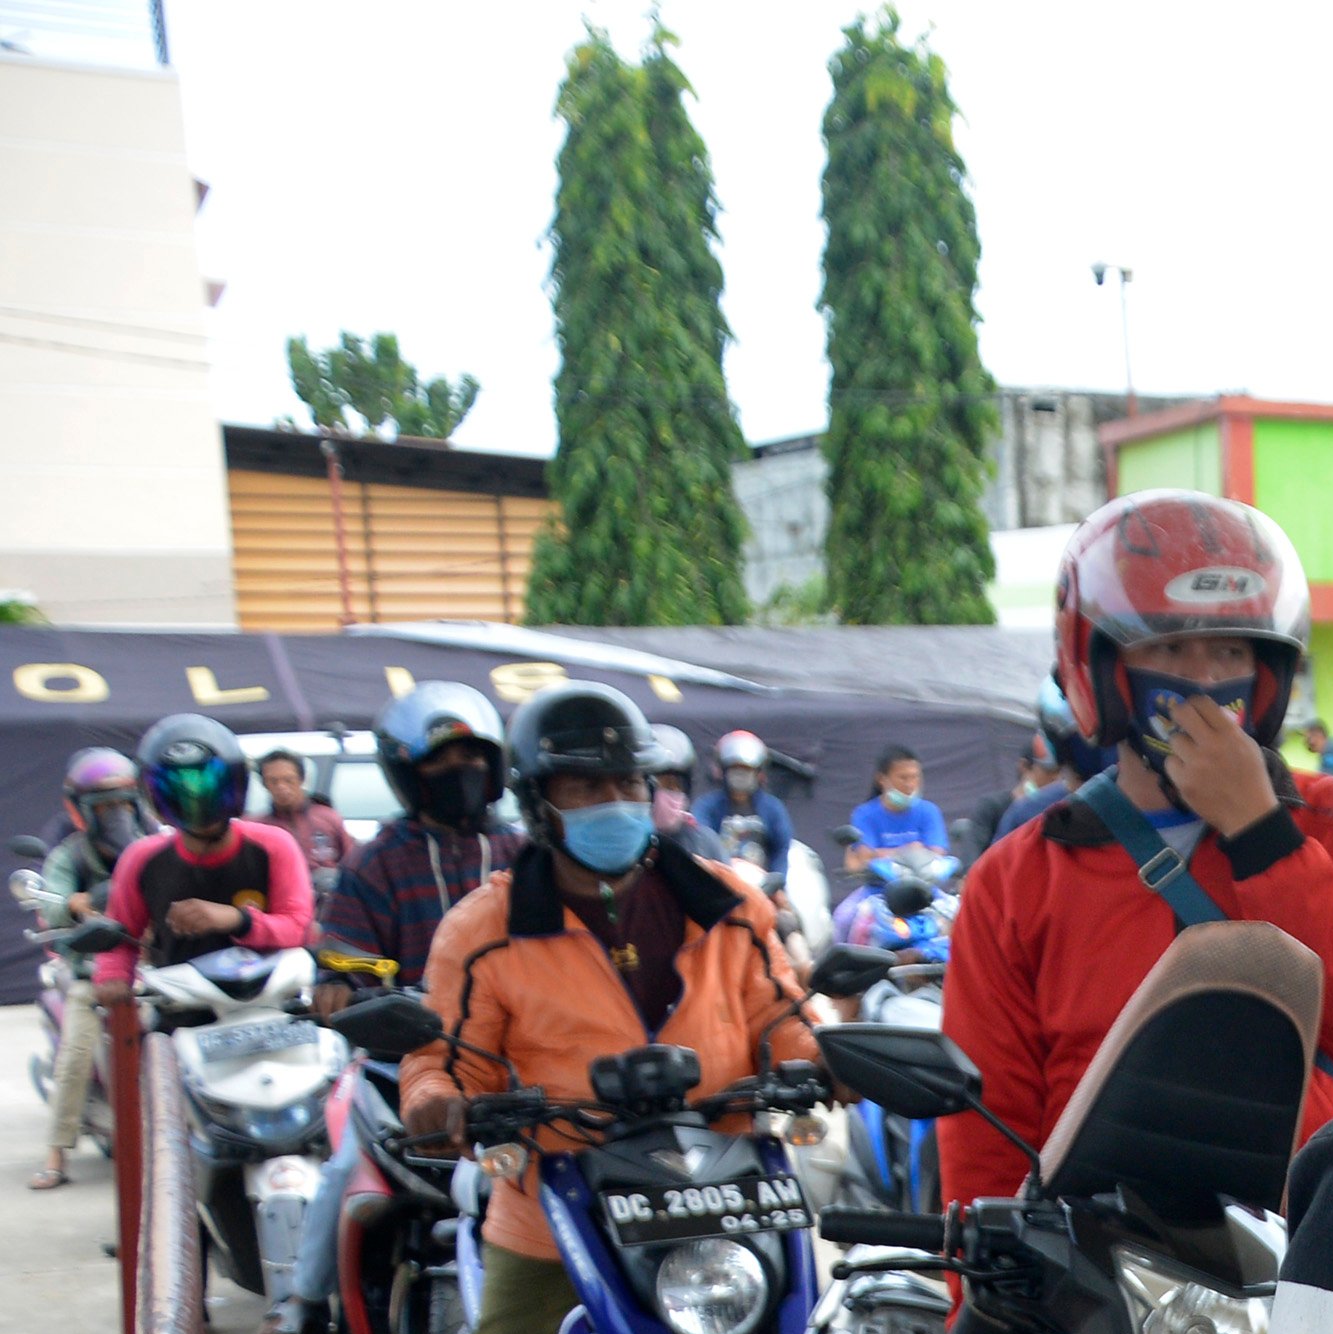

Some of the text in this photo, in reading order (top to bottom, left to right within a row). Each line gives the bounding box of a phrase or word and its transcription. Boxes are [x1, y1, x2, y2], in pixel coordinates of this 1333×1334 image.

[608, 1179, 802, 1223] DC 2805 AW
